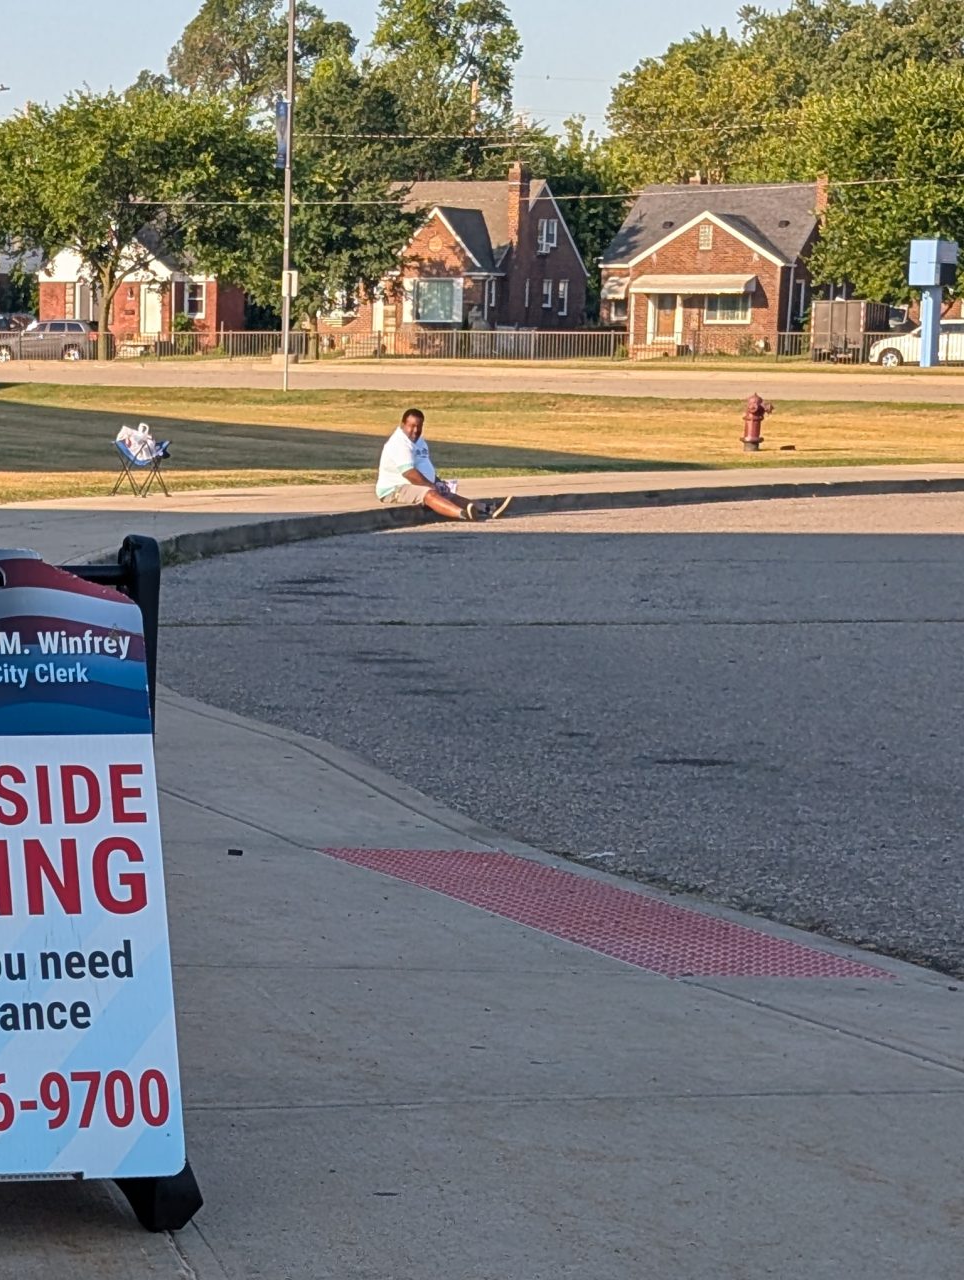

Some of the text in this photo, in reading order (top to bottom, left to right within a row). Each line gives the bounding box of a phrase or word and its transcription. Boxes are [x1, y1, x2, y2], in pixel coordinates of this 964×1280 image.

[0, 631, 30, 655] M.
[37, 630, 130, 660] Winfrey
[35, 662, 89, 684] Clerk
[40, 939, 134, 980] need
